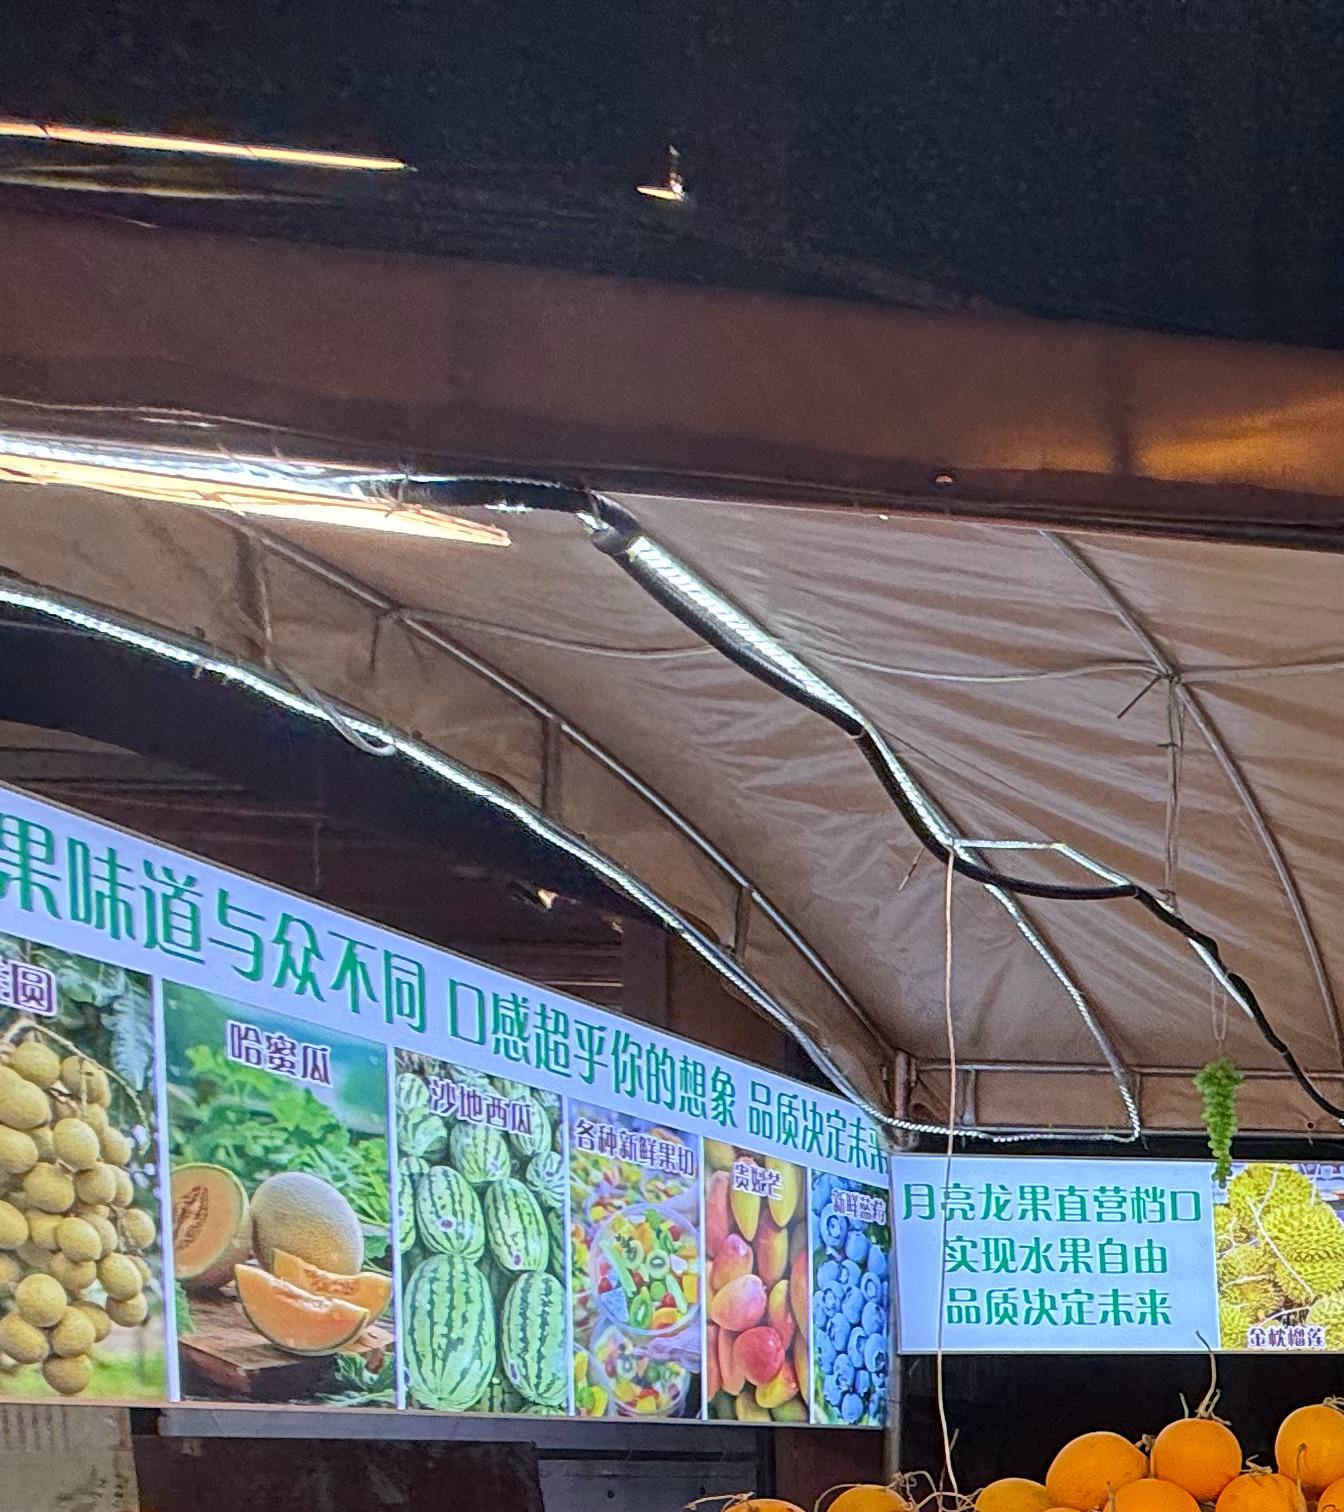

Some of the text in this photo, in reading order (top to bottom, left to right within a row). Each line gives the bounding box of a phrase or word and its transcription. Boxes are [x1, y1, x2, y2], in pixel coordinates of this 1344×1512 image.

[0, 962, 54, 1013] 圆
[0, 813, 887, 1175] 果味道与众不同 口感超乎你的想象 品质决定未来
[430, 1079, 532, 1135] 沙地西瓜
[902, 1183, 1201, 1224] 月亮龙果直营档口
[945, 1236, 1168, 1275] 实现水果自由
[947, 1287, 1172, 1326] 品质决定未来
